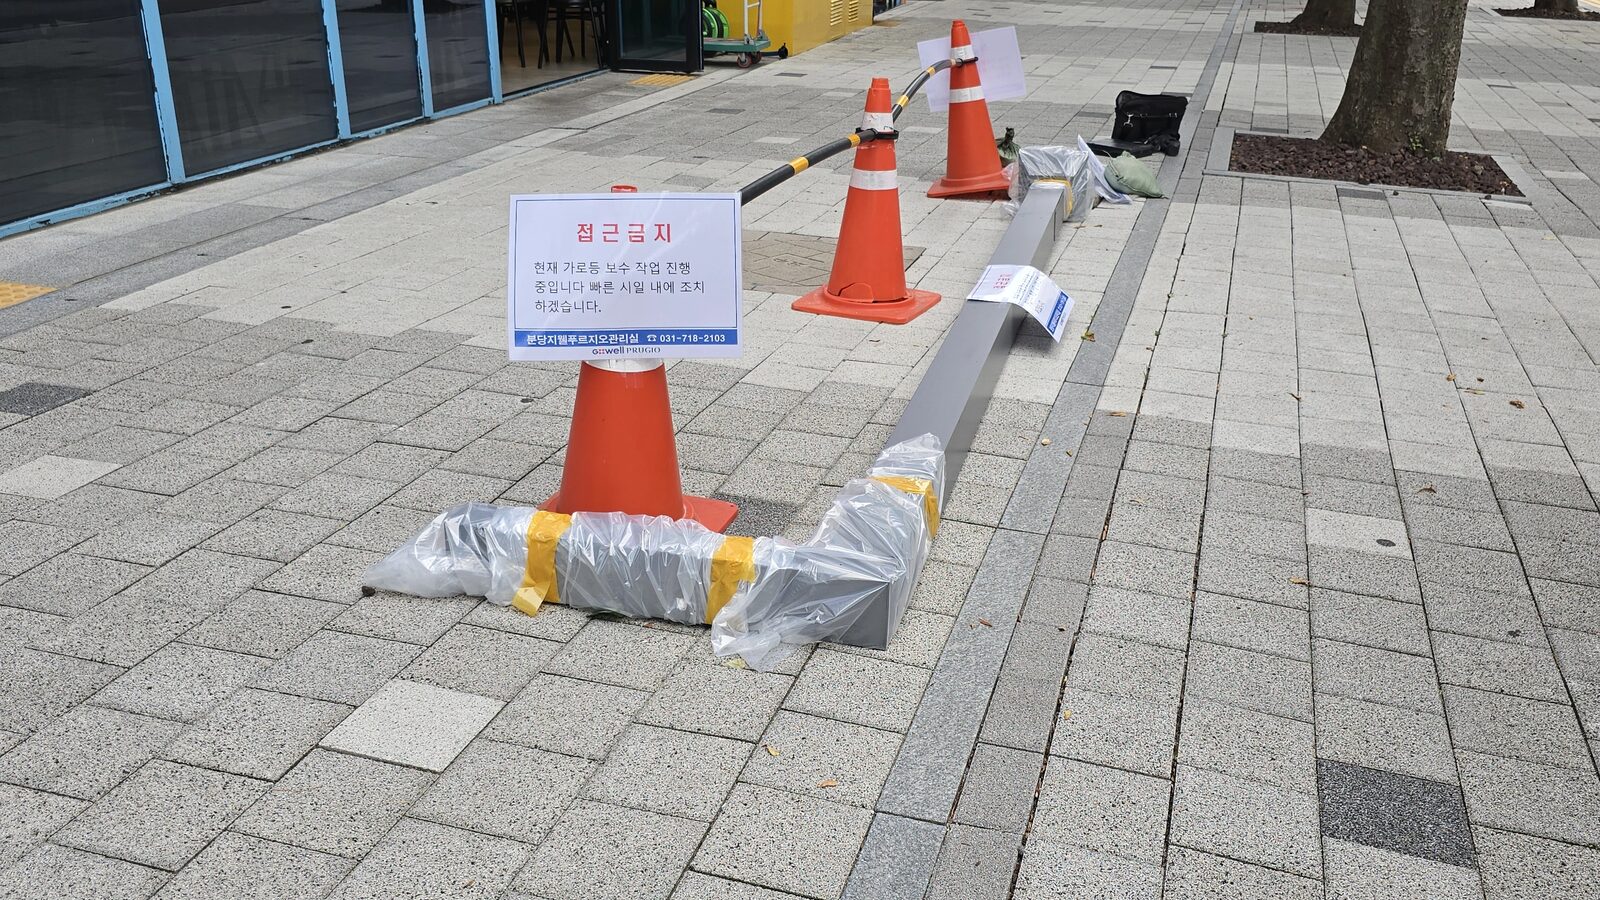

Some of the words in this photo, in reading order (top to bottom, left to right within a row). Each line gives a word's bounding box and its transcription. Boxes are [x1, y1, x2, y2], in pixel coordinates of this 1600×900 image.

[577, 223, 672, 243] 접근금지
[534, 261, 558, 275] 현재
[563, 261, 600, 275] 가로등
[605, 261, 631, 275] 보수
[635, 261, 660, 275] 작업
[666, 261, 691, 275] 진행
[535, 281, 584, 294] 중입니다
[589, 281, 614, 294] 빠른
[620, 281, 645, 294] 시일
[650, 281, 675, 294] 내에
[680, 281, 705, 294] 조치
[535, 300, 602, 313] 하겠습니다.
[526, 333, 639, 345] 분당지웰푸르지오관리실
[660, 334, 726, 343] 031-718-2103
[626, 346, 661, 354] PRUGIO
